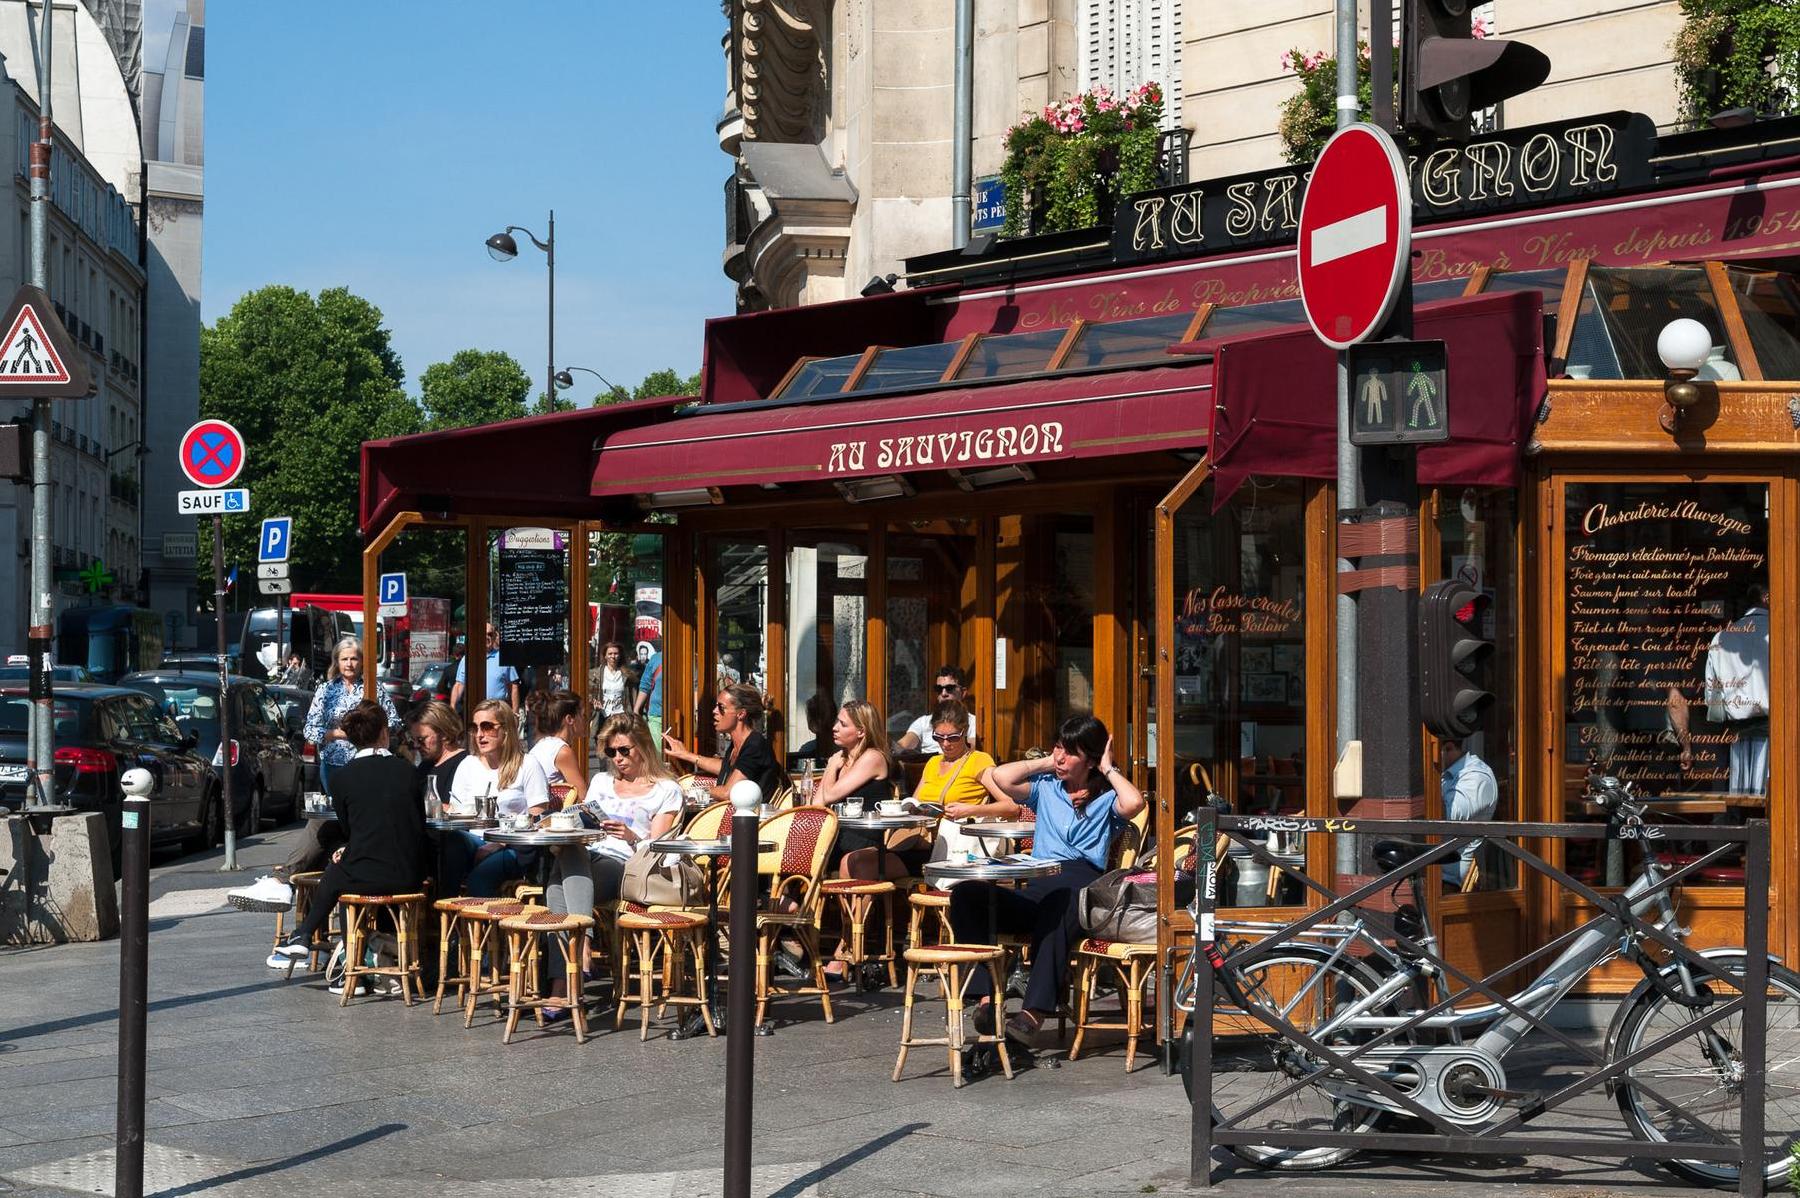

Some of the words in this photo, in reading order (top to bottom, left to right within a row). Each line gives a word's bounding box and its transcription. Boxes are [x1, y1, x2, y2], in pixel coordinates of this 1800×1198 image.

[1133, 187, 1204, 251] AU
[1226, 122, 1617, 238] SAGNON
[976, 191, 988, 203] UE
[1411, 249, 1479, 281] Bar
[1522, 231, 1600, 266] Vins
[1613, 227, 1713, 260] depuis
[1089, 291, 1146, 321] Vins
[1152, 287, 1180, 315] de
[828, 442, 867, 472] AU
[877, 422, 1063, 469] SAUVIGNON
[182, 495, 222, 510] SAUF
[1583, 502, 1670, 534] Charcuterie
[1671, 500, 1752, 536] d'Auvergne
[267, 527, 281, 553] P
[508, 530, 550, 547] Suggestions
[1570, 545, 1629, 568] Fromages
[1570, 566, 1593, 580] Foie
[1616, 569, 1630, 580] mi
[1631, 569, 1650, 580] cuit
[1650, 569, 1682, 580] nature
[1684, 568, 1695, 580] et
[1692, 568, 1729, 585] figues
[387, 579, 399, 599] P
[1613, 585, 1642, 603] fumé
[1642, 587, 1664, 598] sur
[1665, 584, 1697, 598] toasts
[1177, 587, 1207, 621] Nos
[1571, 601, 1620, 615] Saumon
[1206, 613, 1237, 633] Pain
[1572, 621, 1601, 634] Filet
[1601, 621, 1615, 633] de
[1616, 620, 1642, 634] thon
[1570, 637, 1630, 657] Tapenade
[1641, 638, 1663, 651] Cou
